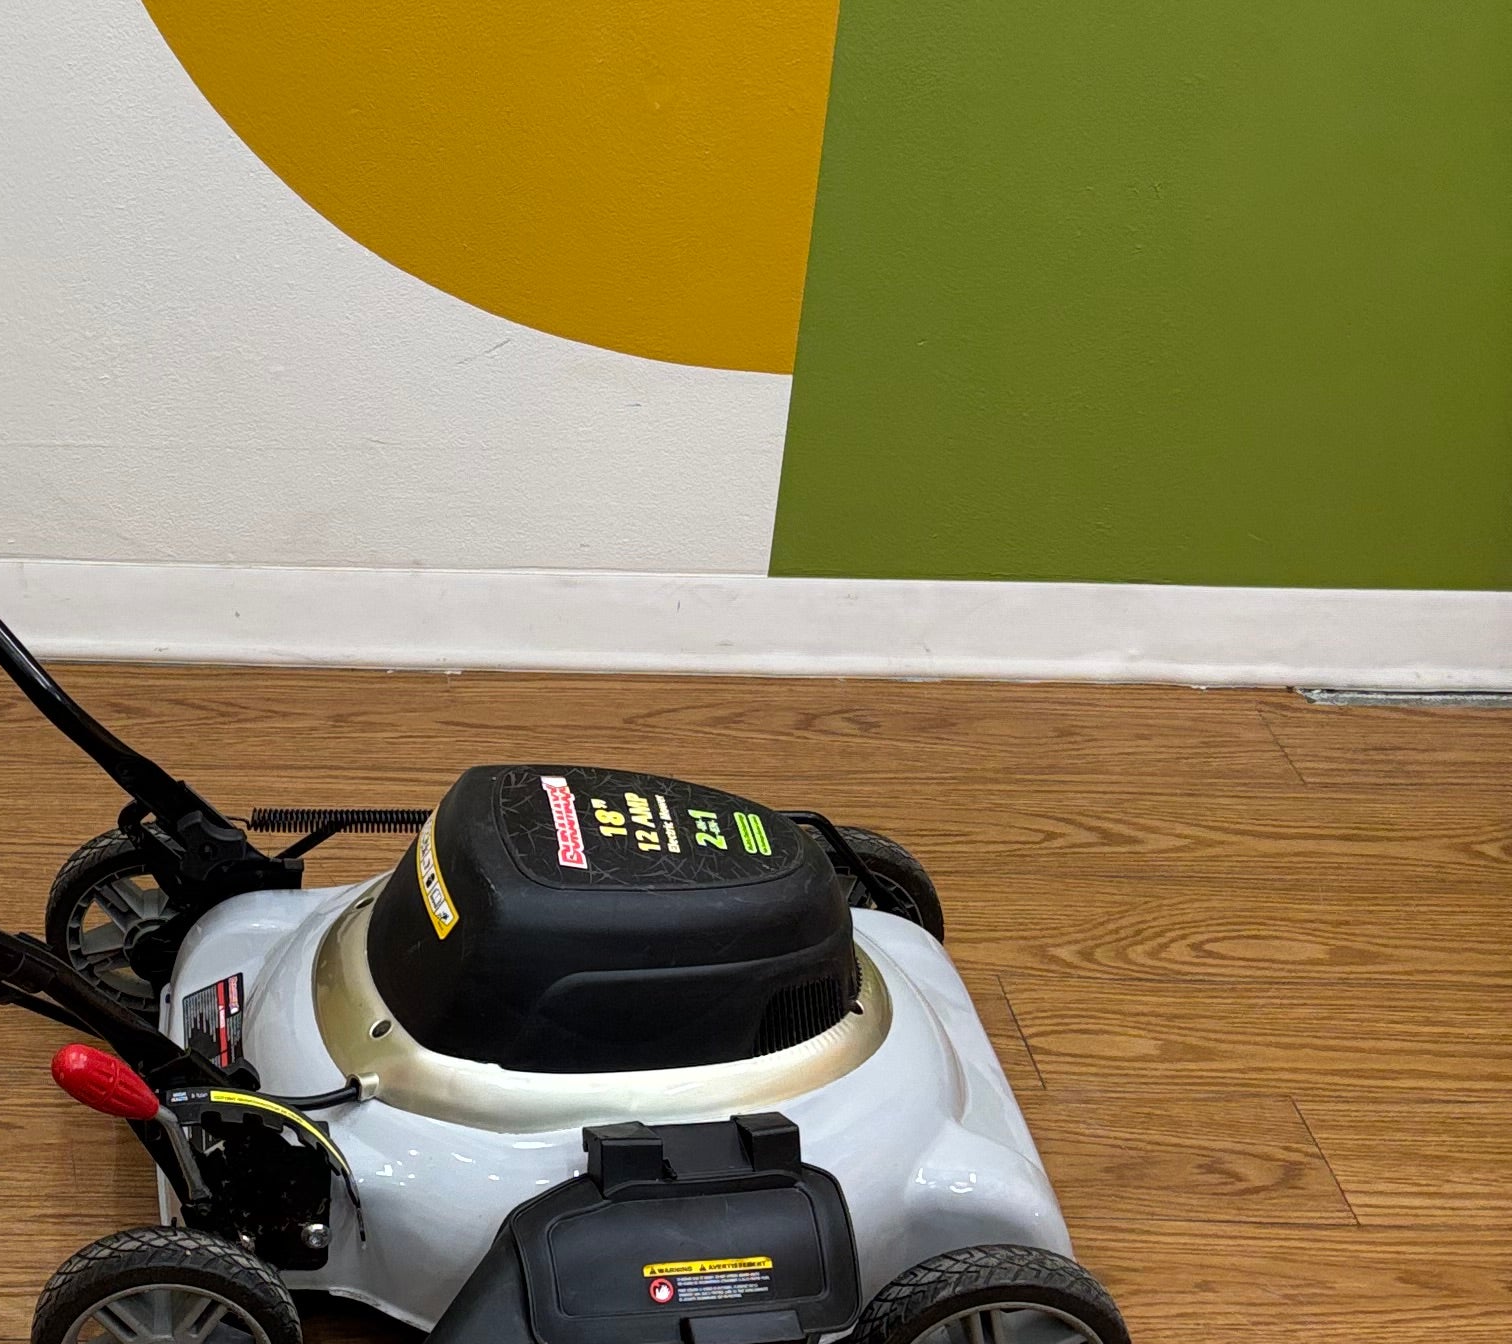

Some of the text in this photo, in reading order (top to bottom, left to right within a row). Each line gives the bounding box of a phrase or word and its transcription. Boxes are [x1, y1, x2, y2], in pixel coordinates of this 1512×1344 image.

[624, 792, 661, 852] 12 AMP
[655, 794, 681, 853] Electric Mower
